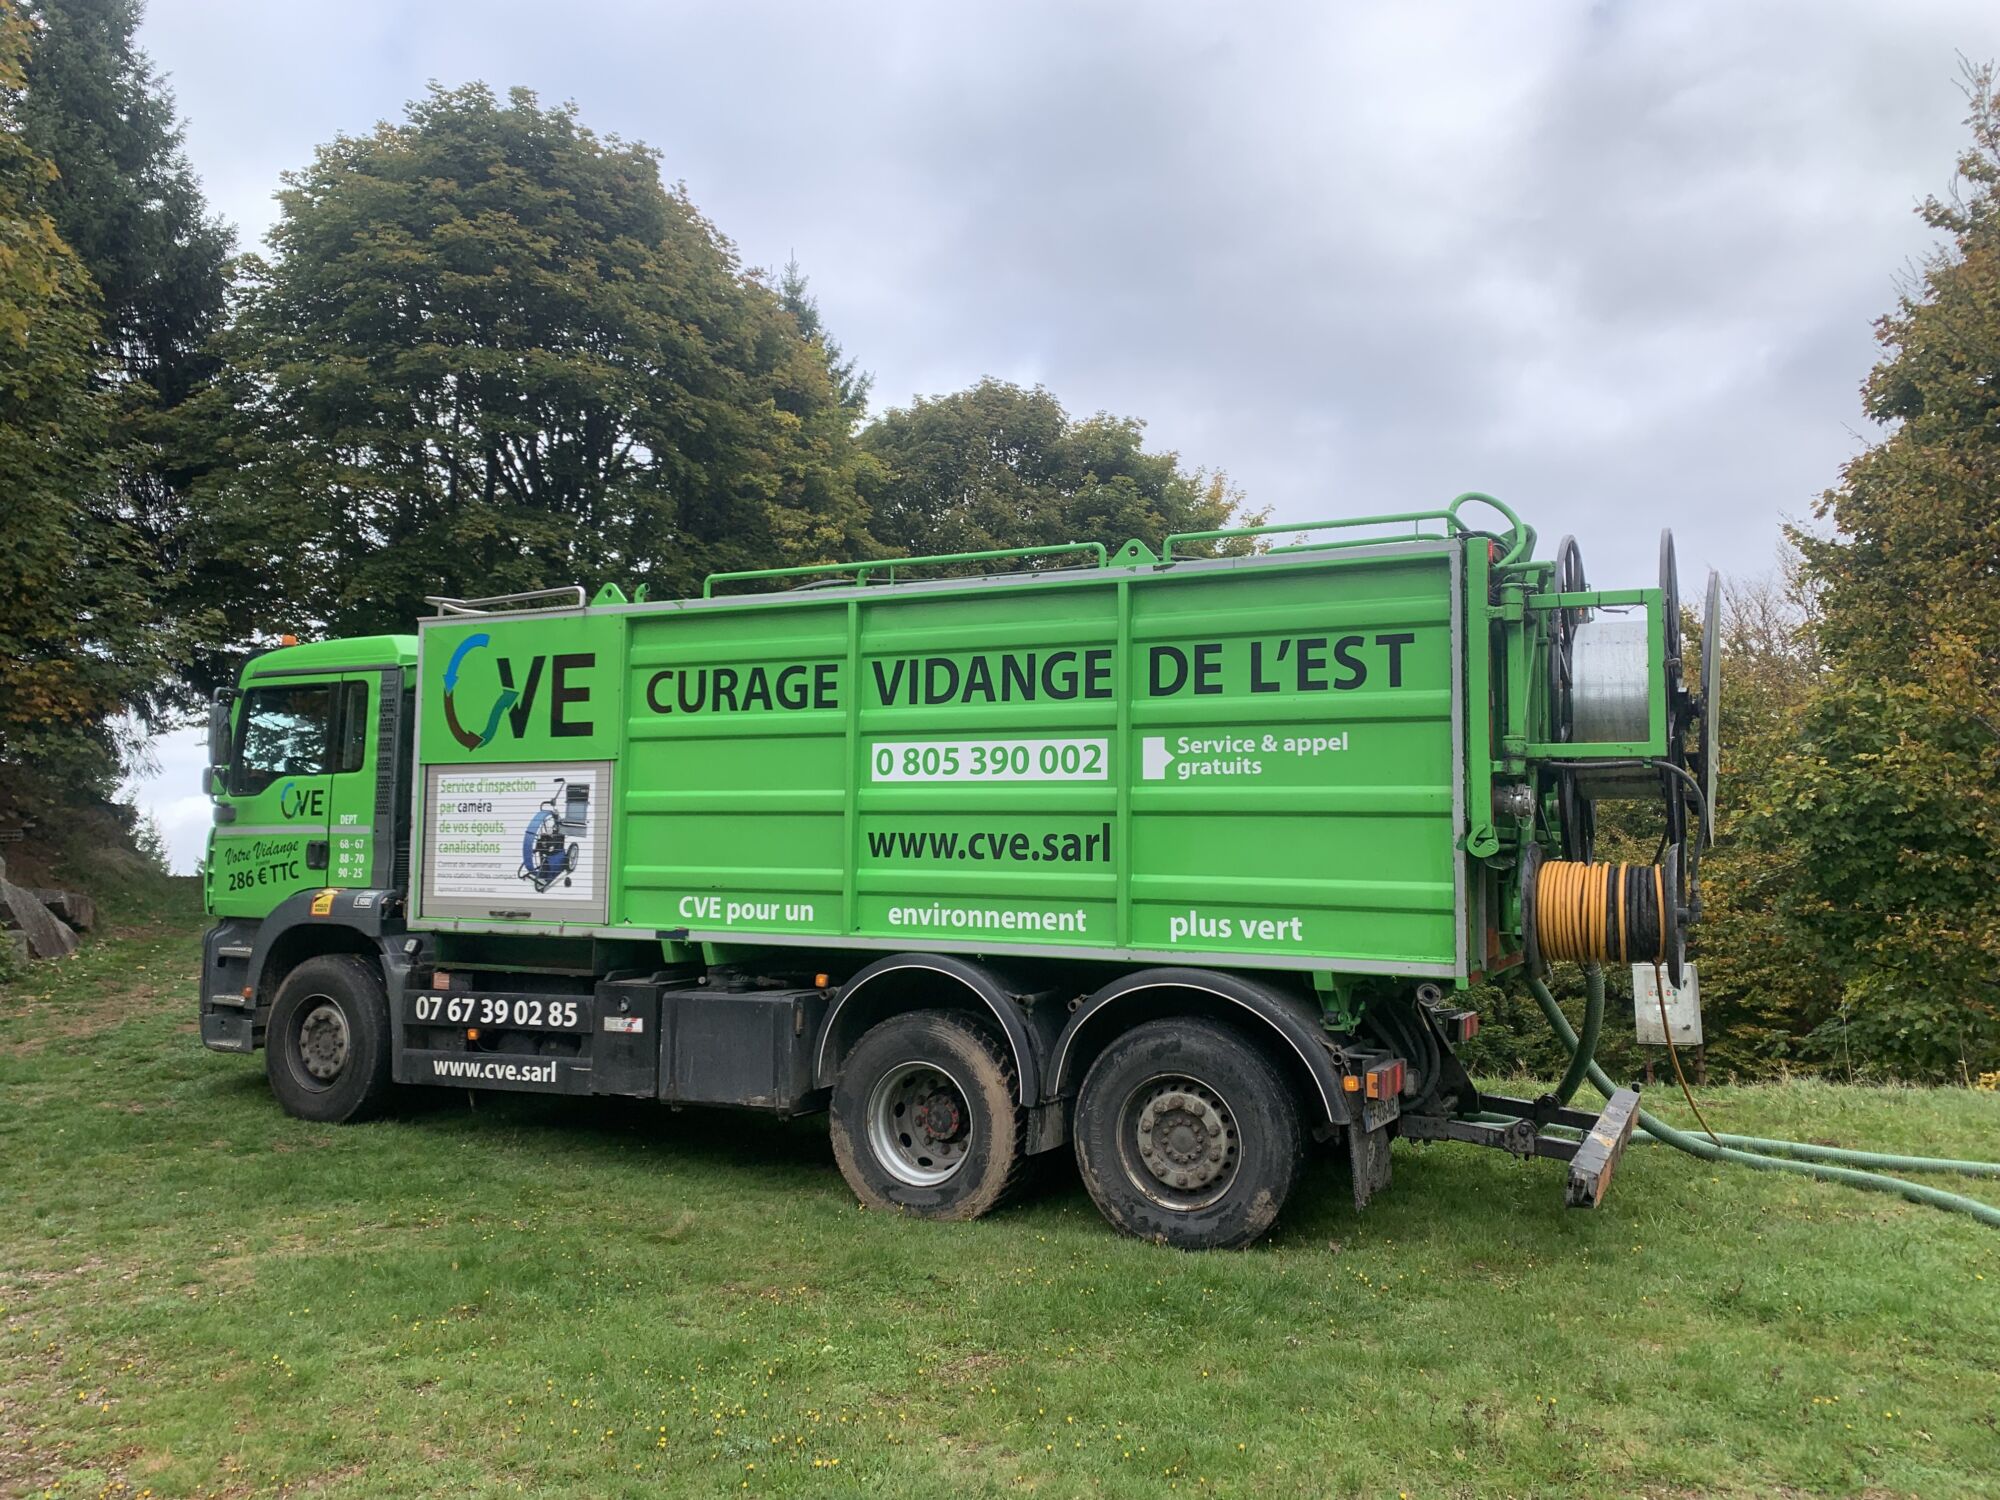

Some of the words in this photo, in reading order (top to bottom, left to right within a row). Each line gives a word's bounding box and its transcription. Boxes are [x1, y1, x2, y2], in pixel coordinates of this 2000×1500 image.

[646, 664, 839, 714] CURAGE
[872, 649, 1113, 706] VIDANGE
[1149, 643, 1224, 696] DE
[1250, 632, 1415, 693] L'EST
[1177, 735, 1255, 754] Service
[1261, 734, 1278, 752] &
[1283, 732, 1348, 756] appel
[876, 747, 894, 776] 0
[902, 746, 960, 776] 805
[969, 745, 1030, 775] 390
[1039, 744, 1102, 774] 002
[1177, 757, 1262, 780] gratuits
[441, 780, 474, 793] Service
[477, 777, 537, 795] d'inspection
[440, 803, 456, 816] par
[457, 799, 492, 812] caméra
[340, 815, 358, 825] DEPT
[440, 820, 451, 833] de
[453, 822, 469, 833] vos
[225, 848, 251, 866] Votre
[253, 840, 299, 860] Vidange
[340, 840, 349, 849] 68
[355, 840, 364, 849] 67
[438, 840, 500, 854] canalisations
[868, 823, 1111, 862] www.cve.sarl
[355, 854, 364, 863] 70
[229, 870, 254, 891] 286
[258, 867, 267, 885] €
[270, 860, 299, 883] TTC
[338, 869, 347, 878] 90
[353, 868, 363, 878] 25
[679, 895, 721, 919] CVE
[726, 899, 780, 924] pour
[785, 903, 814, 922] un
[888, 902, 1087, 932] environnement
[1170, 910, 1232, 942] plus
[1239, 916, 1303, 941] vert
[415, 996, 443, 1021] 07
[447, 998, 476, 1022] 67
[480, 999, 509, 1024] 39
[514, 1000, 542, 1026] 02
[548, 1001, 578, 1027] 85
[433, 1060, 557, 1083] www.cve.sarl
